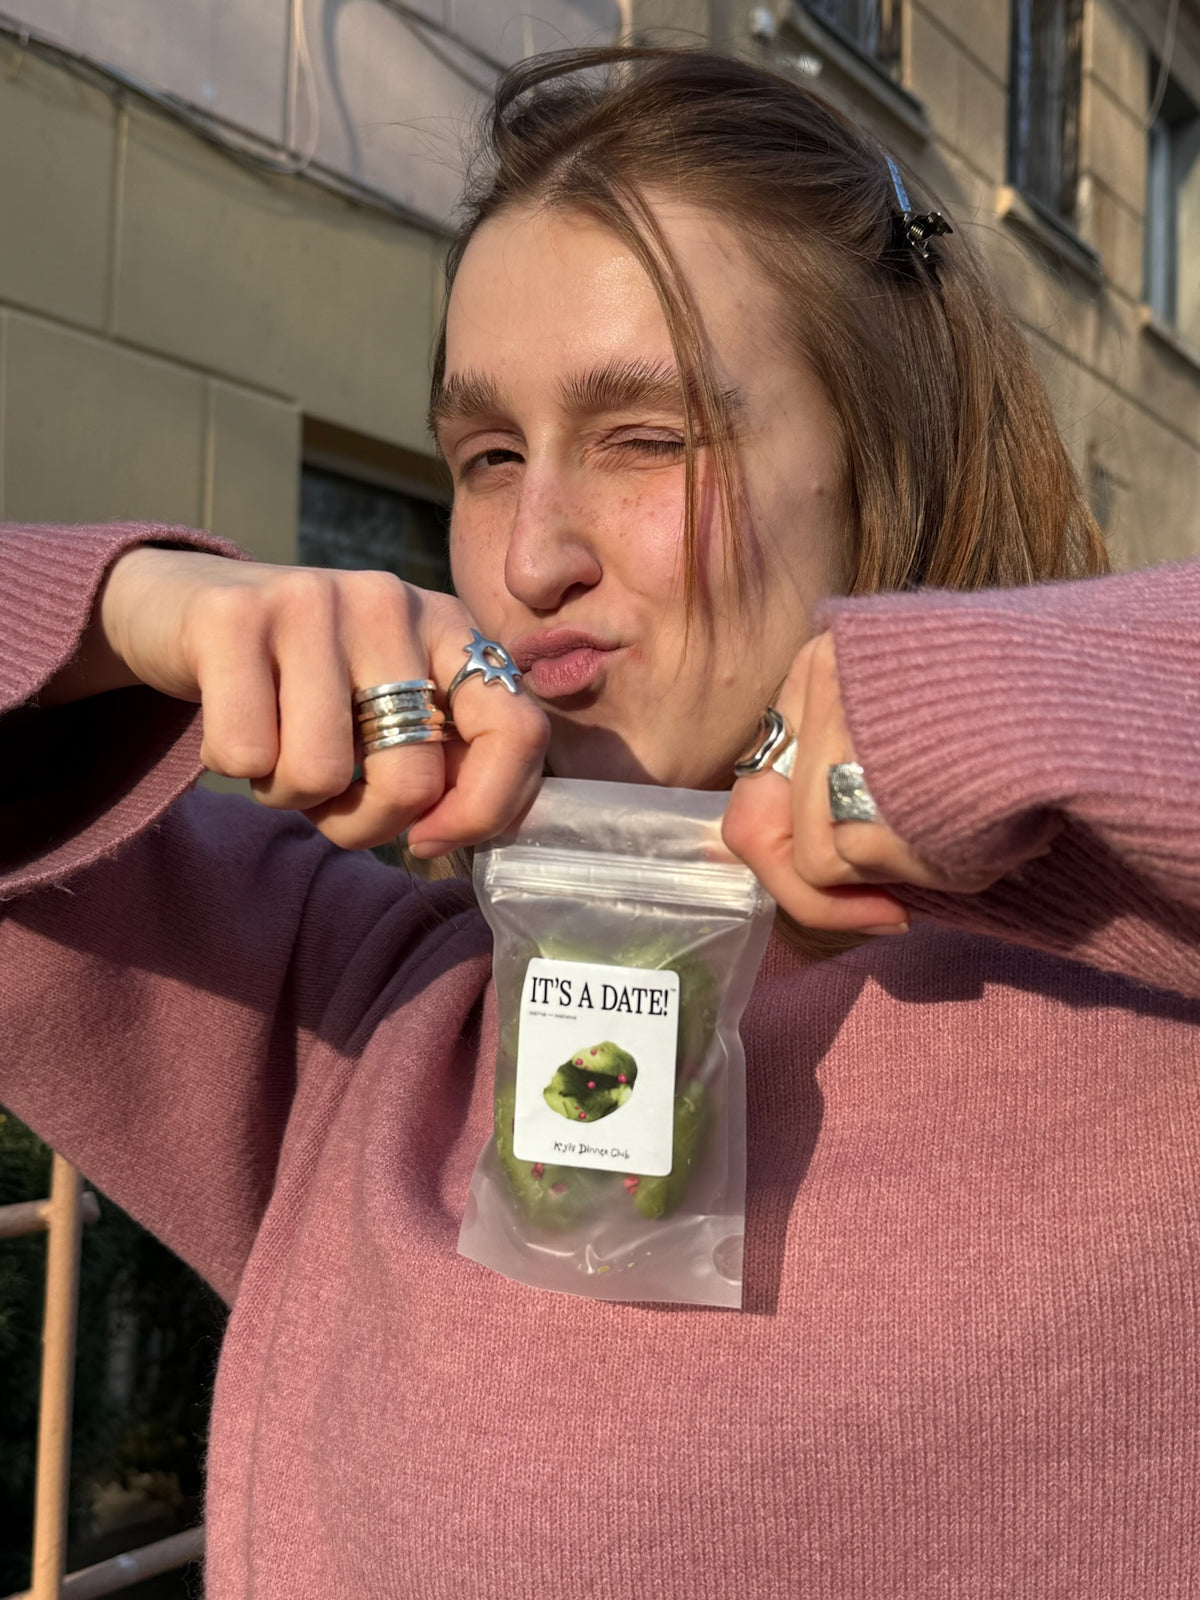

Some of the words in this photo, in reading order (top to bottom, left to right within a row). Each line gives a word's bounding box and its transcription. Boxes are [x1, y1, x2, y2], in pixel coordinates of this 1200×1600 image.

[530, 976, 572, 1007] IT'S
[578, 981, 594, 1009] A
[601, 984, 669, 1016] DATE!
